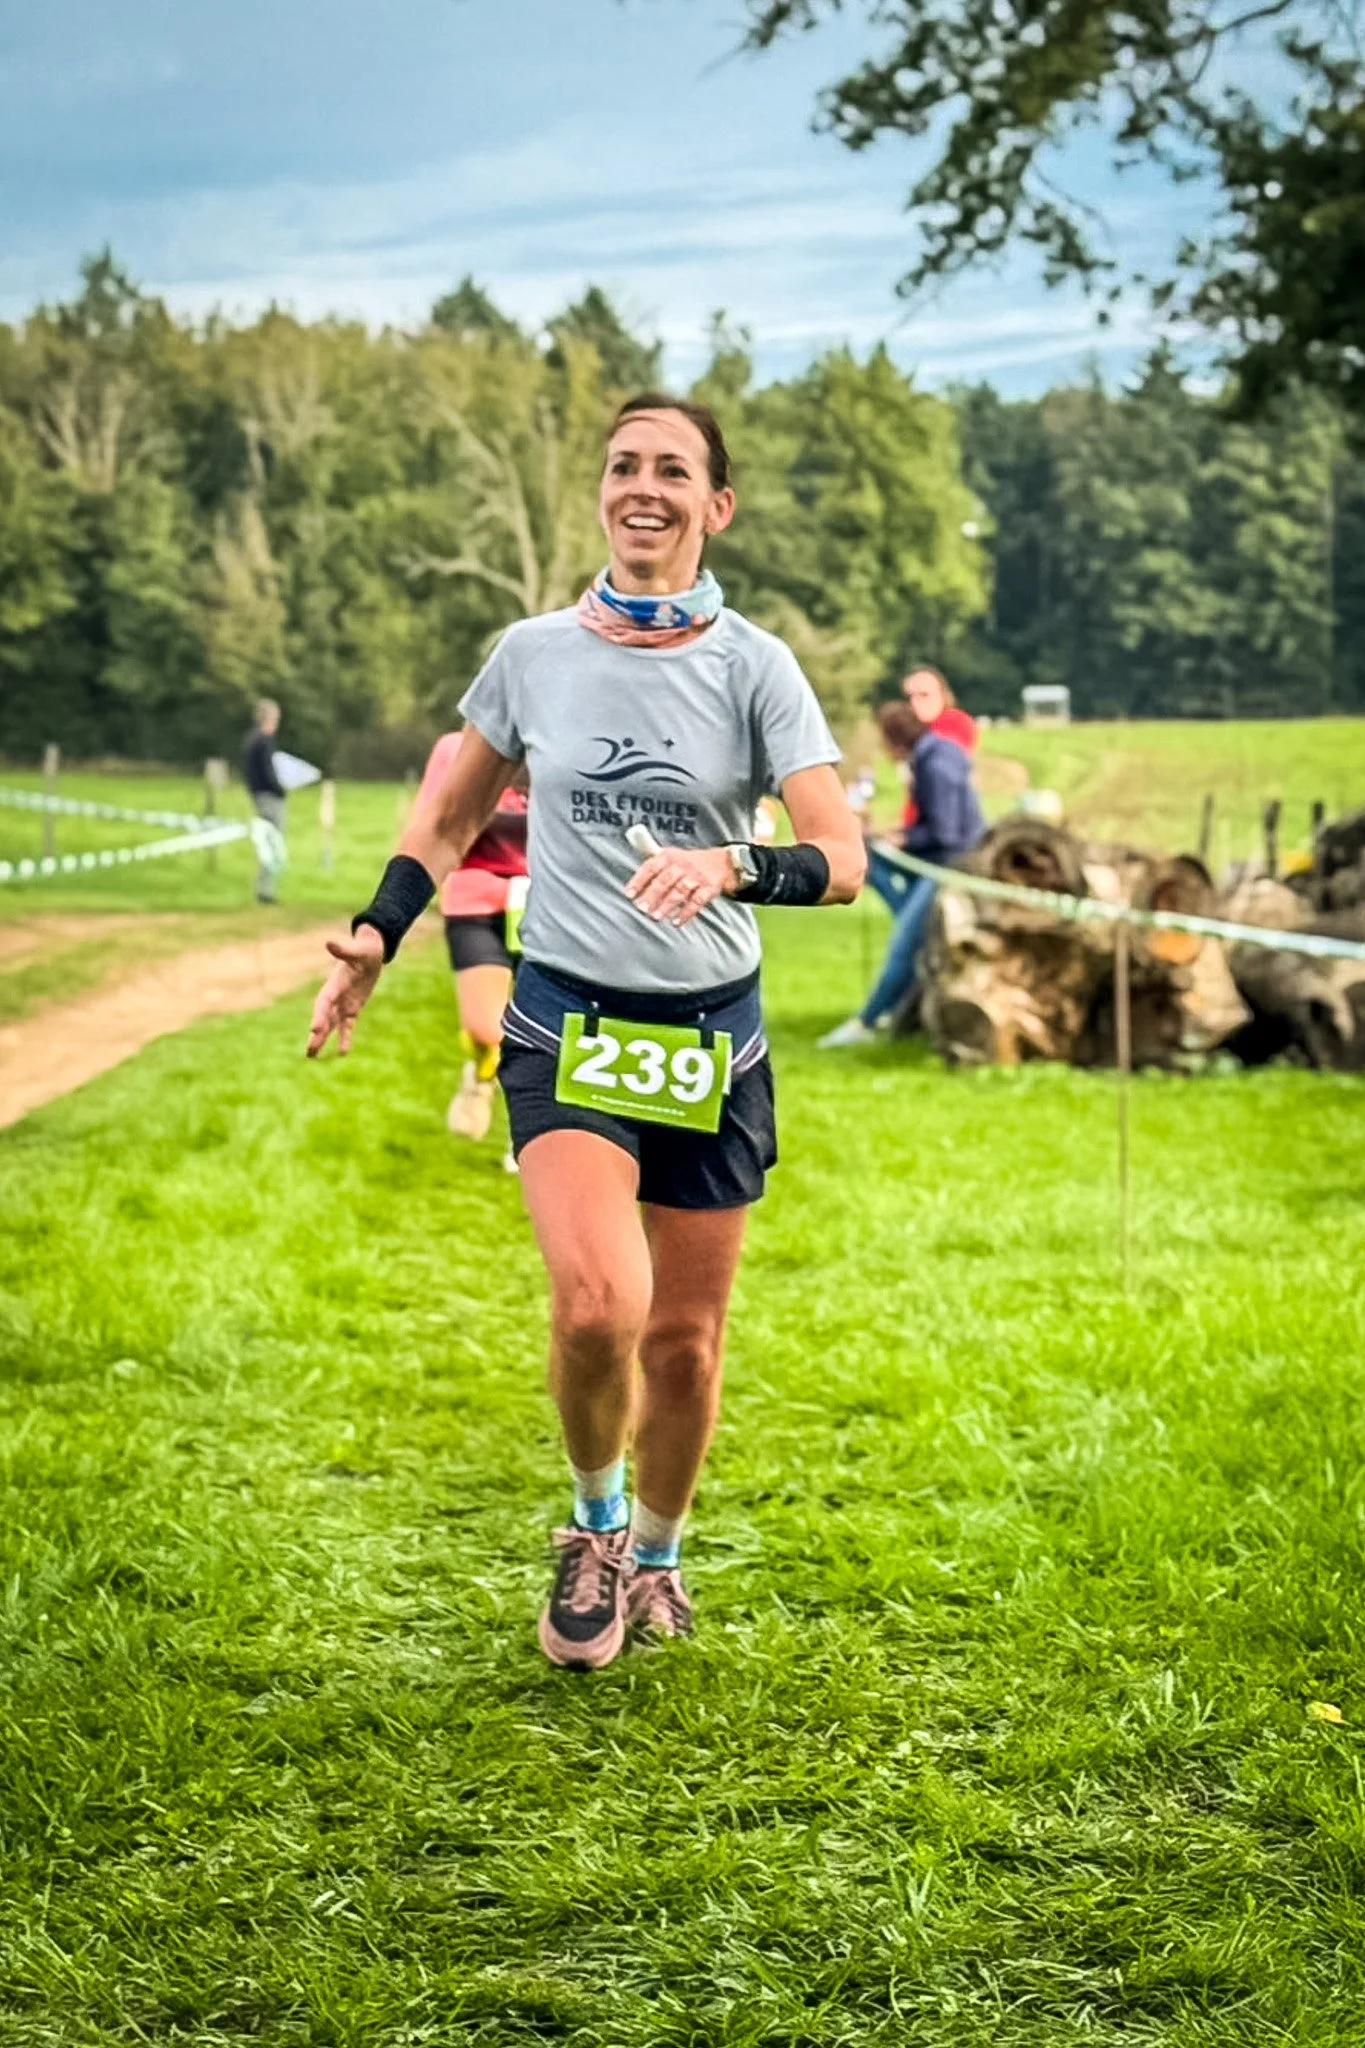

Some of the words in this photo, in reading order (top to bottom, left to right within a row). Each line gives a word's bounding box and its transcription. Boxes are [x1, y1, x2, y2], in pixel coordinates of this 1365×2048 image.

[571, 790, 609, 809] DES
[572, 808, 622, 826] DANS
[657, 817, 696, 835] MER
[571, 1034, 714, 1103] 239
